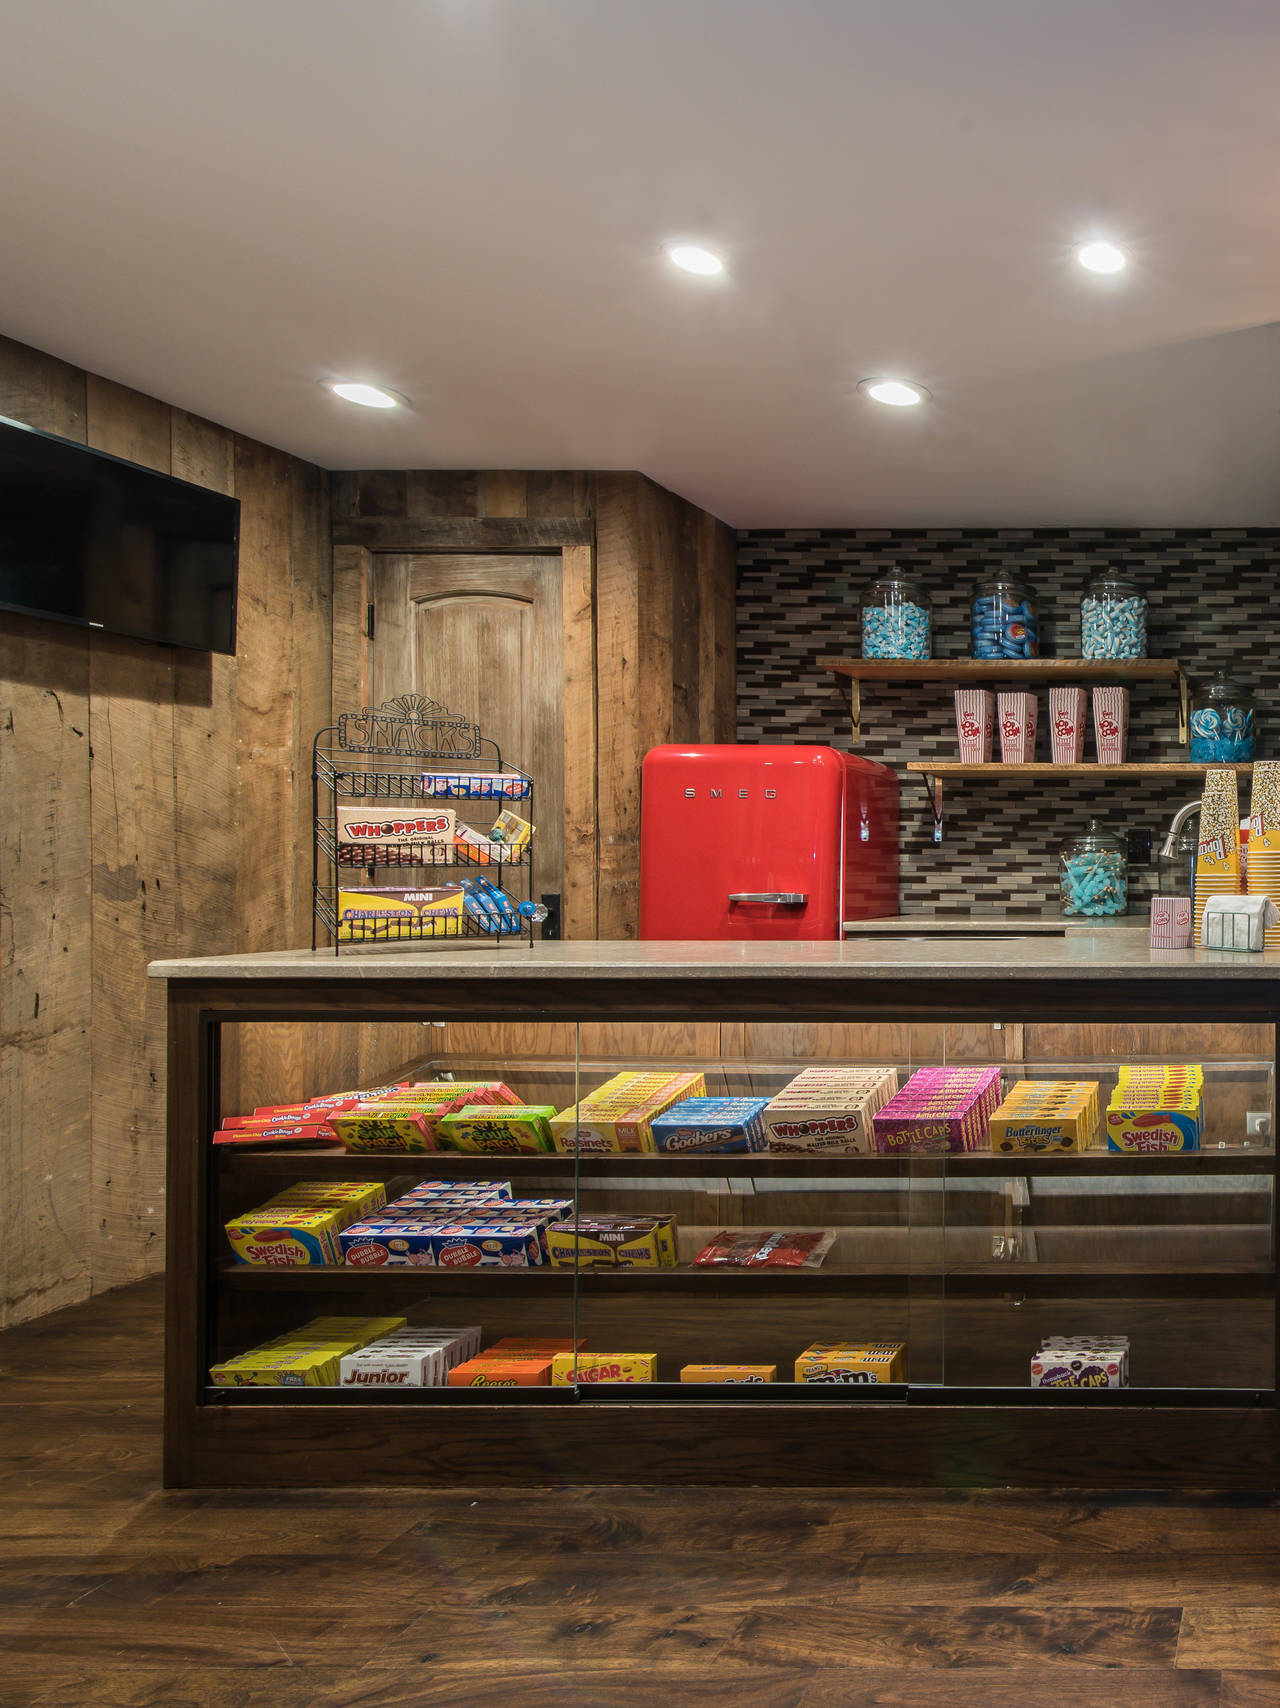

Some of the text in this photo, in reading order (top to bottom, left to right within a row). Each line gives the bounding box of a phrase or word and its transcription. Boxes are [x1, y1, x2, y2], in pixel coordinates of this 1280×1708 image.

[349, 719, 475, 753] SNACKS
[684, 788, 777, 799] SMEG
[347, 818, 448, 837] WHOPPERS
[403, 893, 433, 902] MINI
[343, 909, 414, 920] CHARLESTON
[617, 1127, 635, 1135] MILK
[771, 1117, 856, 1136] WHOPPERS
[1005, 1126, 1063, 1138] Butterfinger
[359, 1128, 399, 1138] SOUR
[472, 1130, 513, 1140] SOUR
[887, 1123, 951, 1146] BOTTLE CAPS
[1121, 1128, 1179, 1147] Swedish
[361, 1138, 408, 1149] PATCH
[477, 1140, 521, 1150] PATCH
[665, 1128, 732, 1151] Goobers
[599, 1233, 625, 1241] MINI
[245, 1243, 306, 1259] Swedish
[350, 1246, 376, 1261] DUBBLE
[443, 1245, 469, 1260] DUBBLE
[618, 1248, 651, 1260] CHEWS
[360, 1250, 385, 1265] BUBBLE
[453, 1250, 478, 1265] BUBBLE
[805, 1365, 823, 1373] PEANUT
[343, 1368, 410, 1384] Junior
[470, 1375, 517, 1386] Reese's
